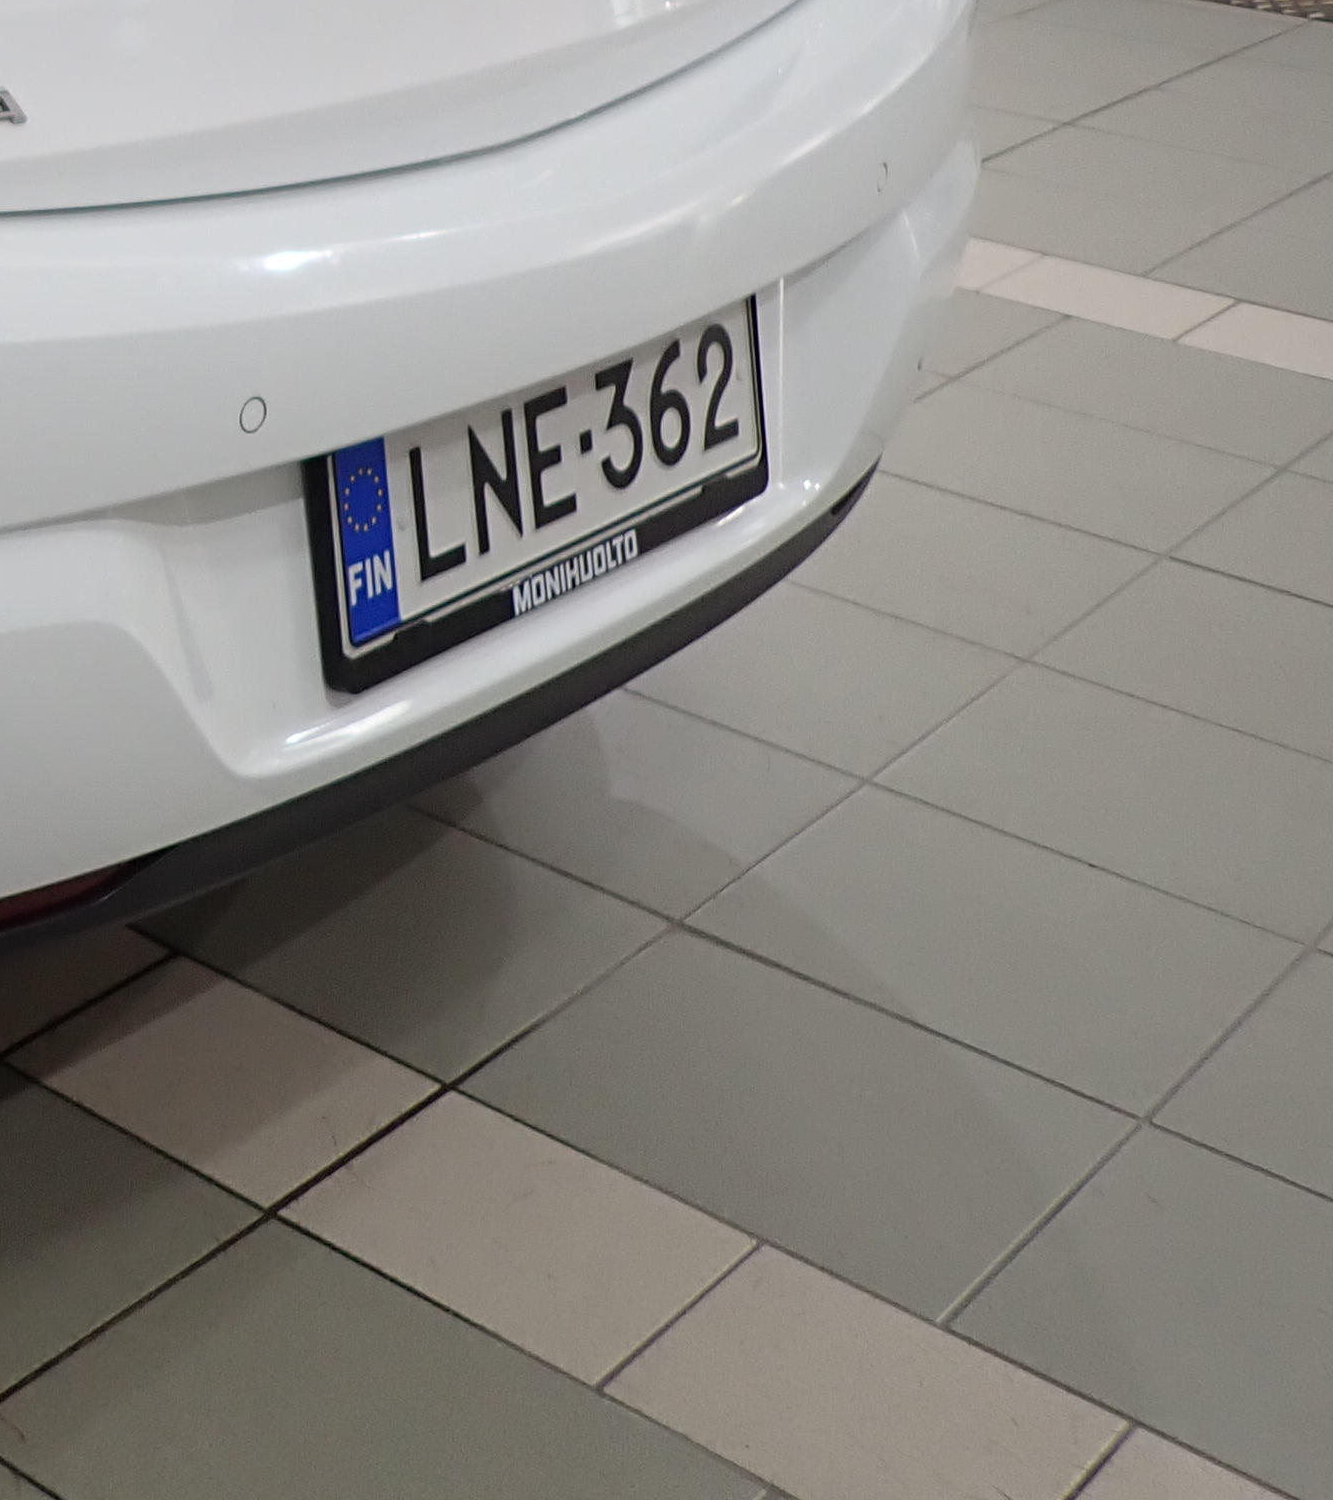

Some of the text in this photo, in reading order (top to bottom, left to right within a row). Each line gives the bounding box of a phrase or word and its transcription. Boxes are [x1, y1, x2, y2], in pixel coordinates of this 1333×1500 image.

[410, 323, 740, 581] LNE-362
[349, 550, 393, 606] FIN
[512, 530, 639, 617] MONIHUOLTO
